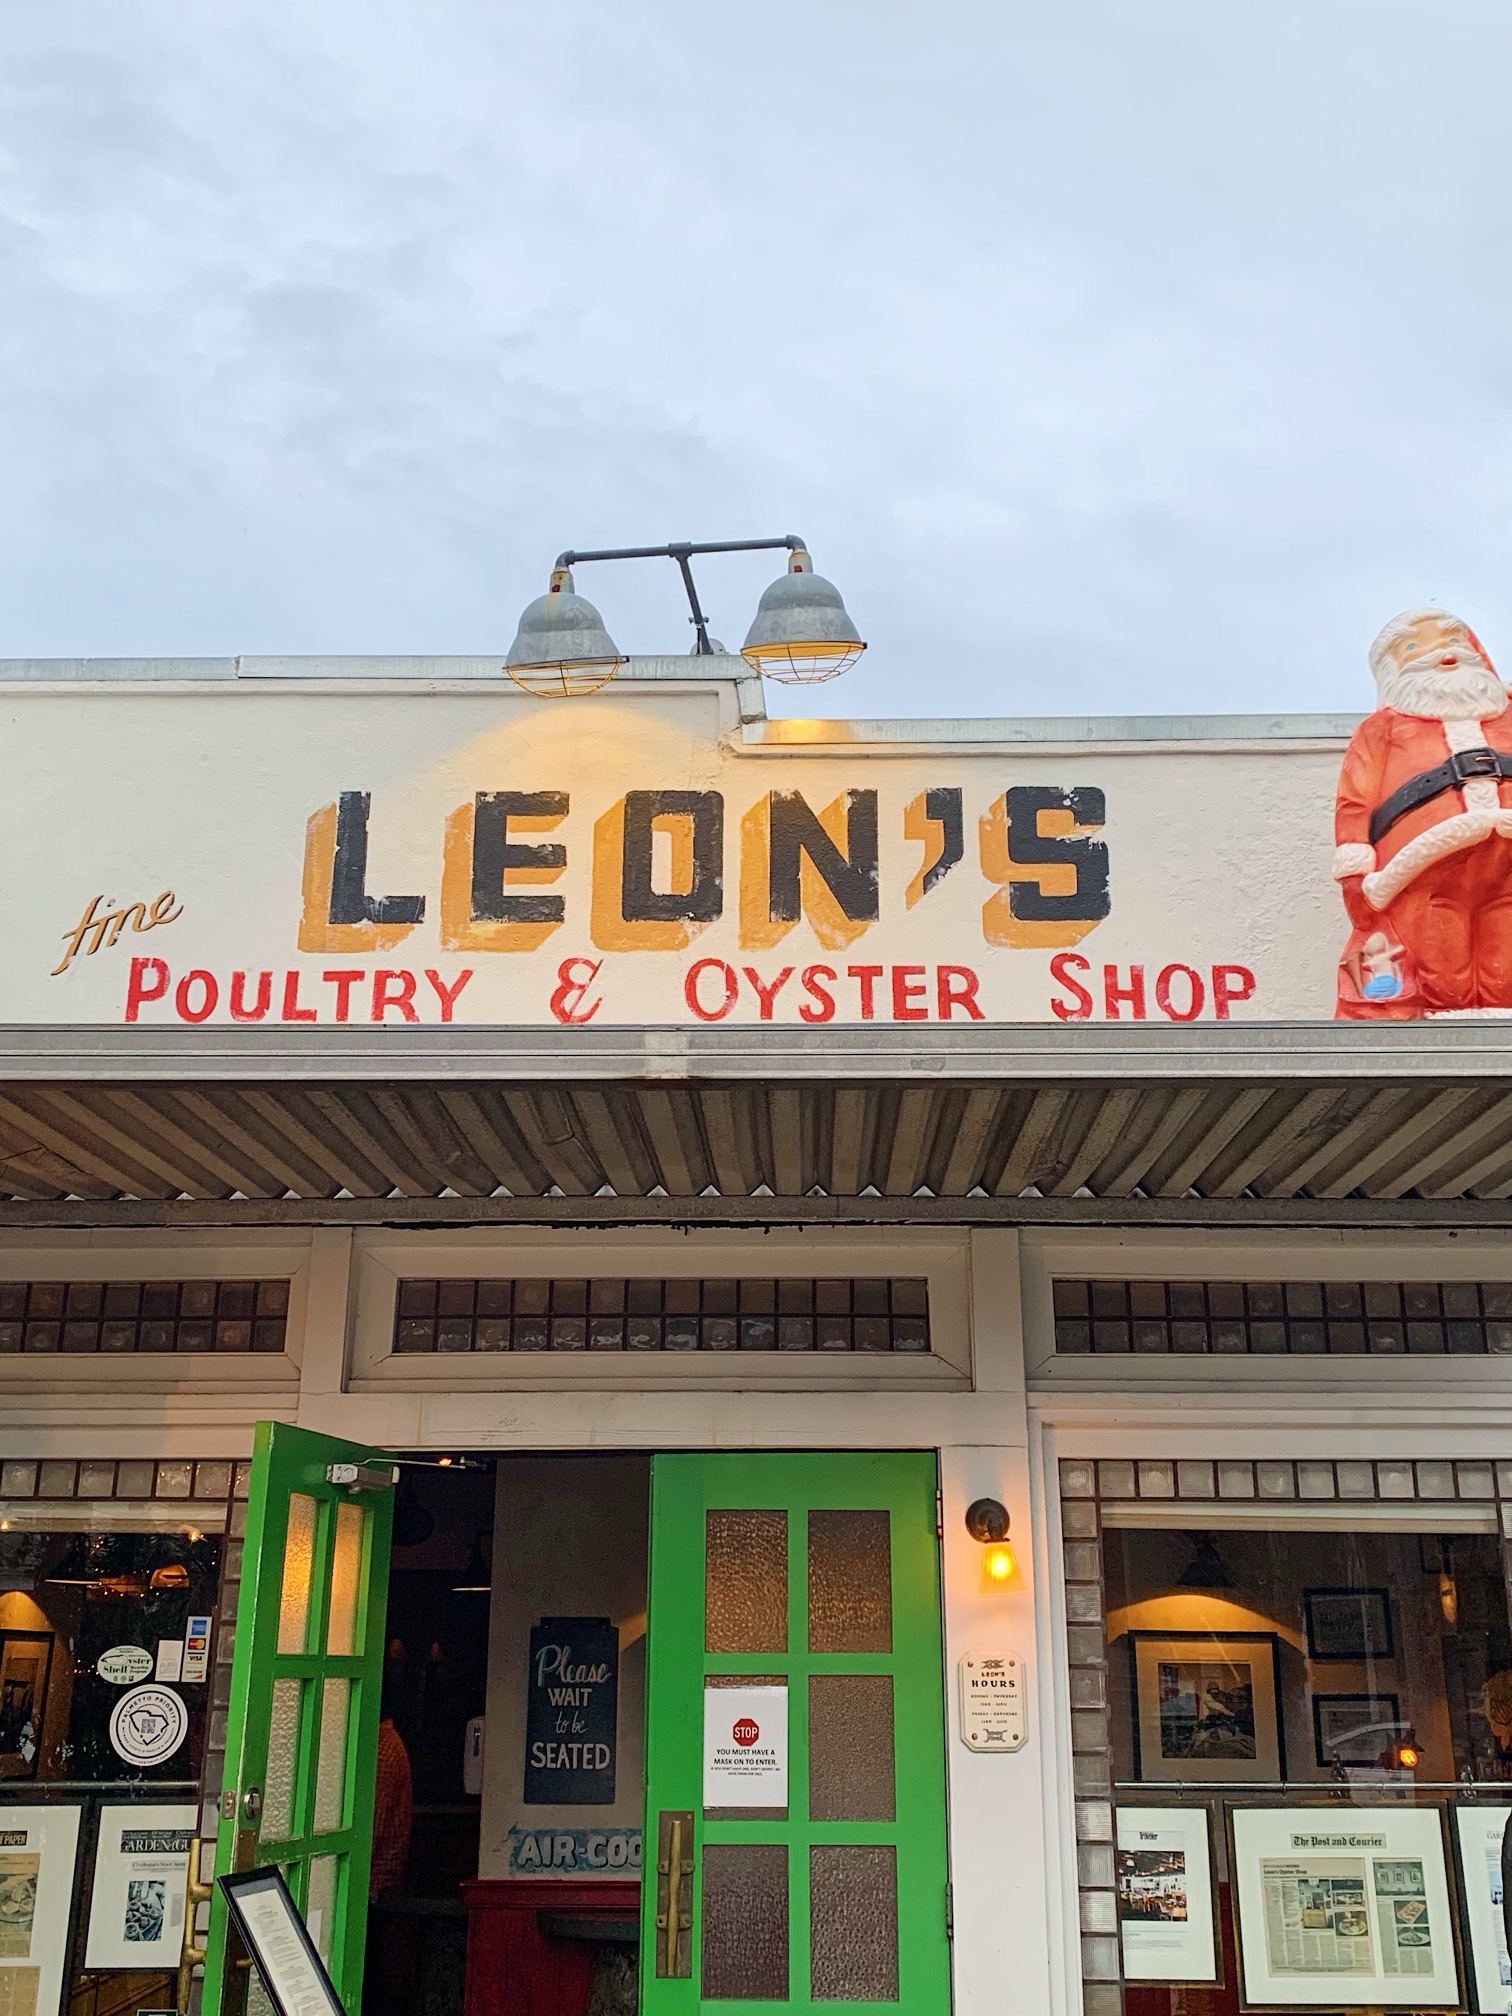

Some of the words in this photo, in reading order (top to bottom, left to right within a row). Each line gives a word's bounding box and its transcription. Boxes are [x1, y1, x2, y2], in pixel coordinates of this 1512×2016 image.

[298, 786, 1111, 952] LEON'S
[50, 891, 184, 976] fine
[125, 957, 474, 1023] POULTRY
[550, 958, 604, 1025] &
[684, 957, 986, 1022] OYSTER
[1049, 953, 1256, 1022] SHOP
[535, 1644, 611, 1687] Please
[122, 1696, 152, 1723] PALMETTO
[155, 1696, 176, 1724] PRIORITY
[548, 1688, 593, 1706] WAIT
[555, 1711, 569, 1734] to
[572, 1710, 588, 1734] be
[734, 1726, 758, 1738] STOP
[530, 1742, 611, 1770] SEATED
[518, 1835, 642, 1868] AIR-COO
[1294, 1836, 1309, 1846] The
[1311, 1836, 1330, 1848] Post
[1332, 1836, 1347, 1846] and
[1349, 1836, 1382, 1846] Courier
